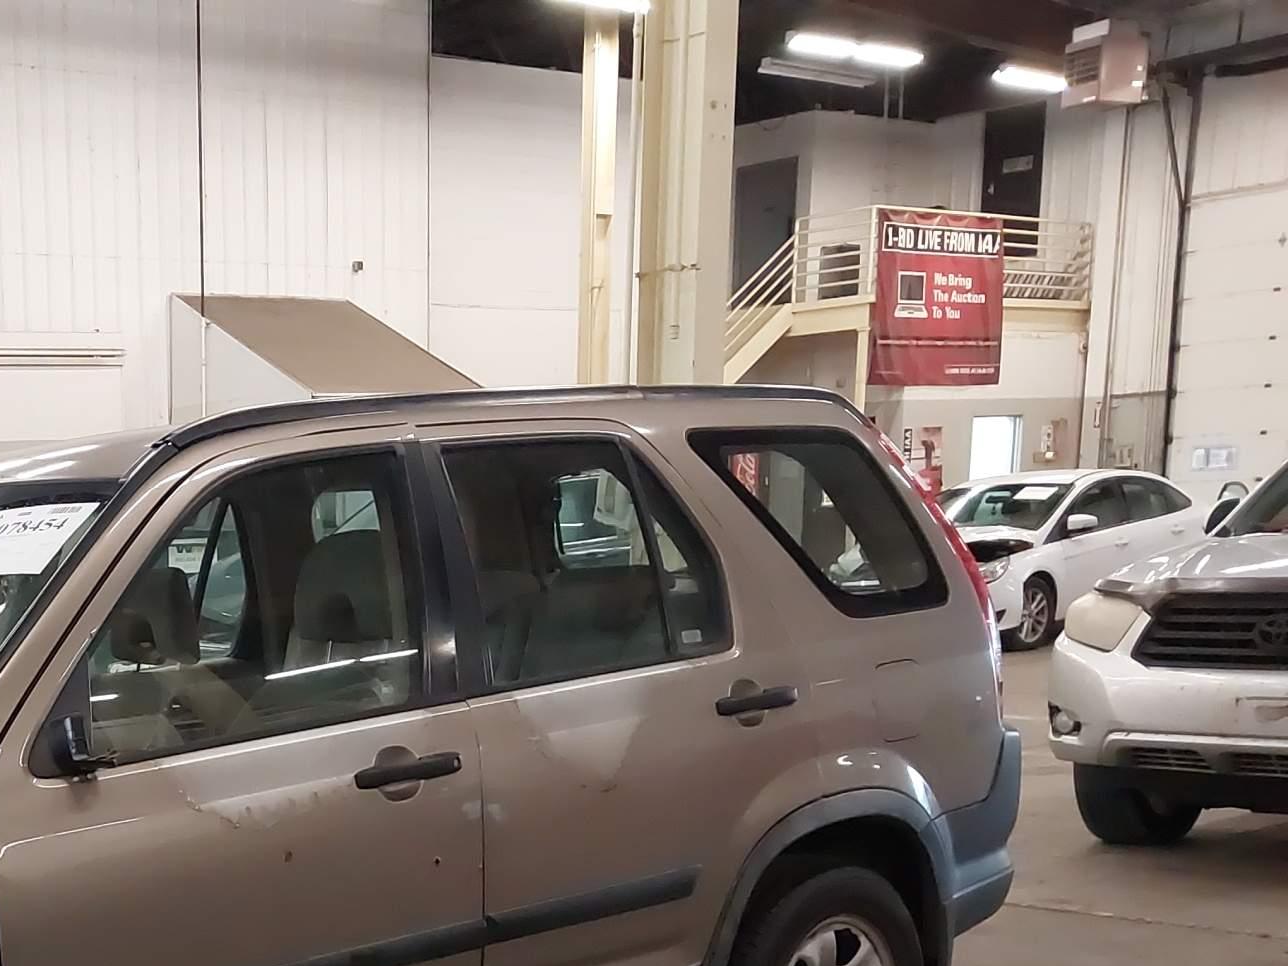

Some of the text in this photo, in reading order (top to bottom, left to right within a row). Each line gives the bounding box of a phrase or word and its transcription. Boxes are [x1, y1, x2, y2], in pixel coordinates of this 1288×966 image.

[917, 229, 942, 251] LIVE
[943, 231, 975, 253] FROM
[934, 272, 972, 290] We Bring
[933, 289, 949, 303] The
[931, 305, 960, 319] To You
